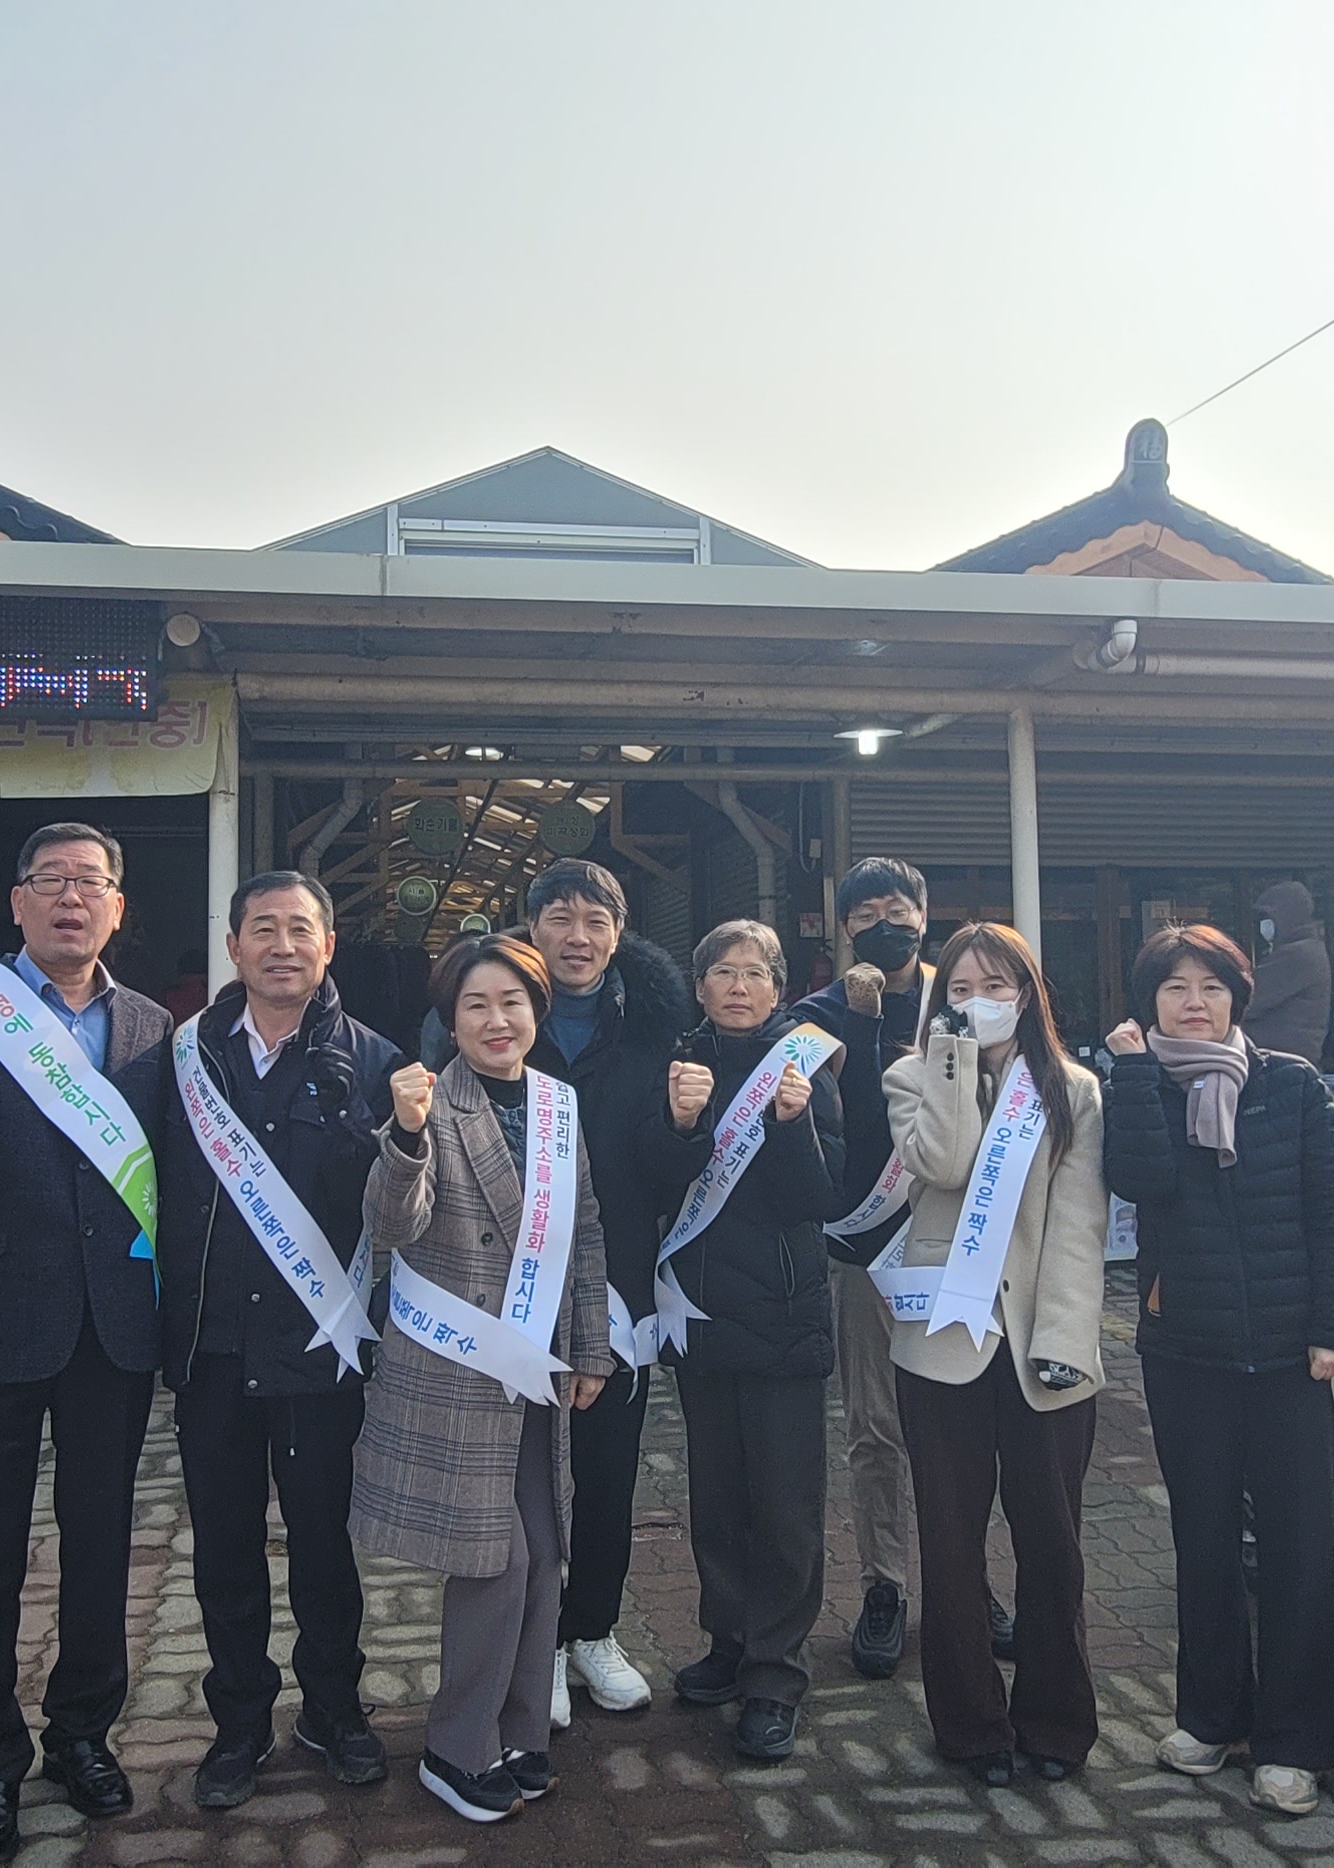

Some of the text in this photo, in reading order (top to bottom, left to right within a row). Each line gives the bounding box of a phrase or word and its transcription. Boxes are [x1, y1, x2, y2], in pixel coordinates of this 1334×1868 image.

[27, 1040, 129, 1148] 동참합시다
[1002, 1088, 1029, 1123] 홀수
[1018, 1098, 1044, 1141] 표기는
[192, 1065, 267, 1178] 건물번호 표기는
[555, 1108, 571, 1161] 편리한
[673, 1070, 778, 1240] 왼쪽은 홀수 오른쪽은
[715, 1141, 750, 1190] 표기는
[973, 1126, 1014, 1209] 오른쪽은
[184, 1077, 328, 1300] 왼쪽은 홀수 오른쪽은 짝수
[510, 1074, 555, 1326] 도로명주소를 생활화 합시다
[842, 1193, 887, 1229] 합시다
[960, 1210, 988, 1257] 짝수
[893, 1290, 931, 1312] 합시다
[432, 1321, 478, 1356] 짝수
